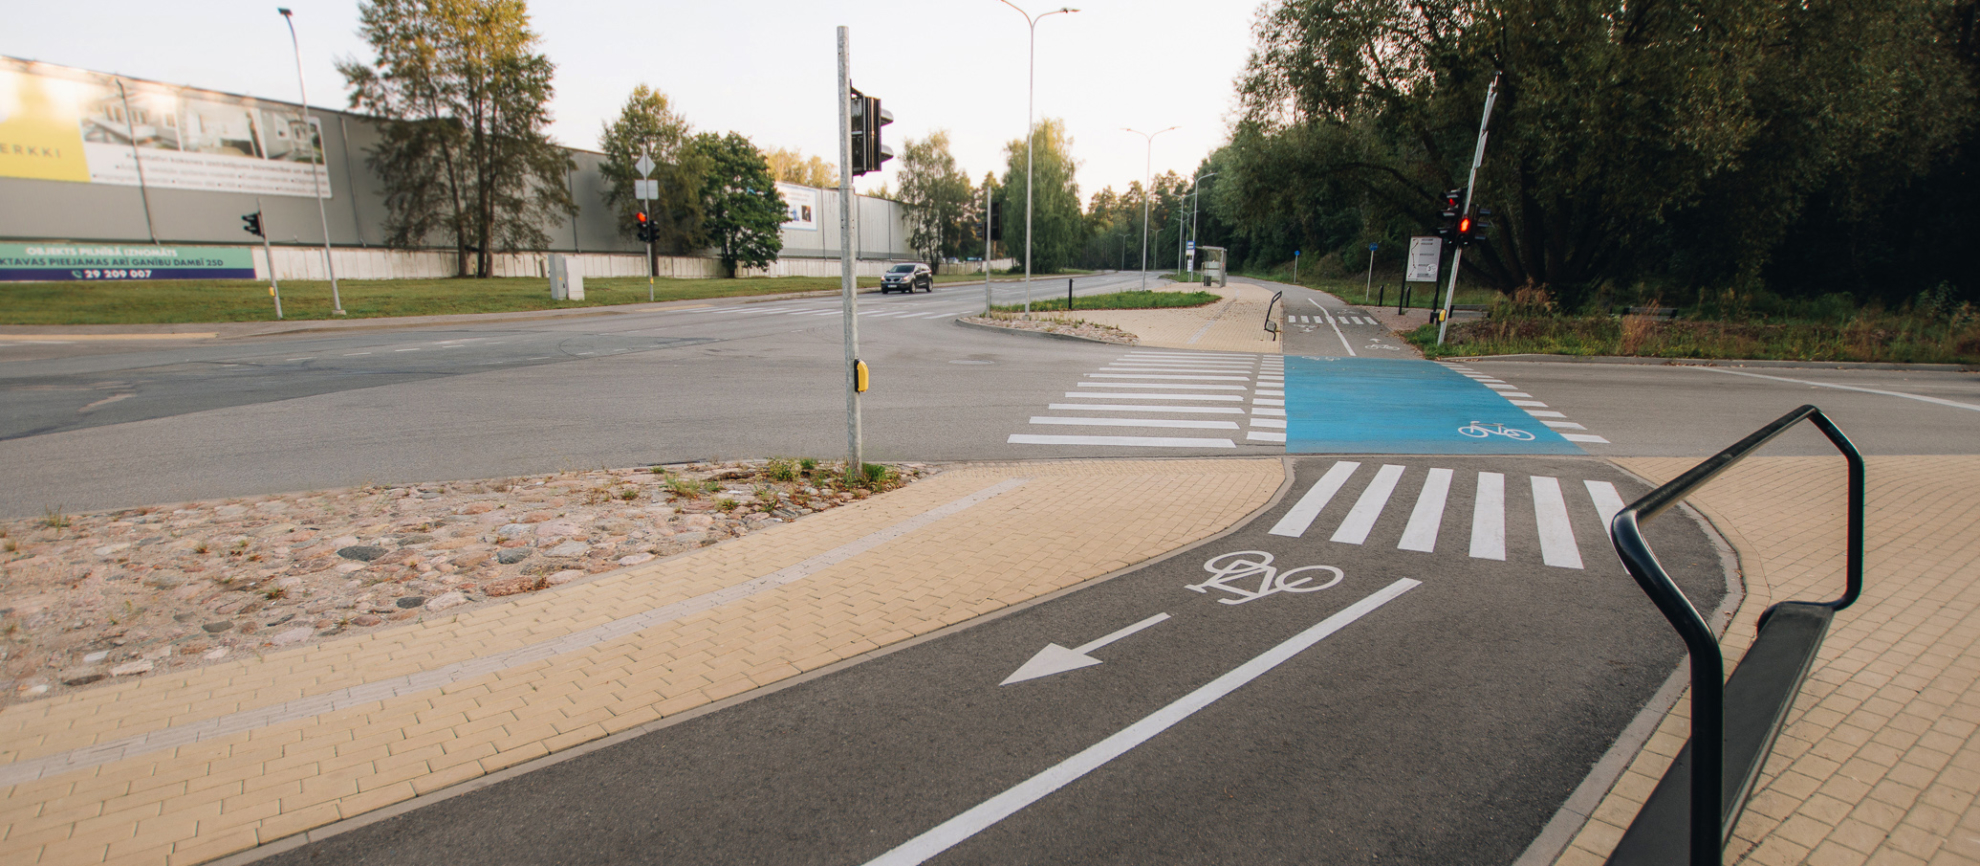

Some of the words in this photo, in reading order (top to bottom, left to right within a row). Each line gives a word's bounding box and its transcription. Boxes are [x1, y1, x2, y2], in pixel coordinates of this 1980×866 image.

[0, 143, 61, 158] ERKKI
[26, 247, 77, 256] OBJEKTS
[79, 246, 123, 256] PILNĪBĀ
[123, 248, 178, 257] IZNOMĀTS
[0, 258, 46, 266] KTAVAS
[49, 258, 109, 266] PIEEJAMAS
[112, 257, 130, 266] ARĪ
[131, 257, 172, 266] GANĪBU
[173, 257, 205, 266] DAMBĪ
[85, 270, 101, 279] 29
[104, 270, 127, 279] 209
[130, 270, 152, 279] 007
